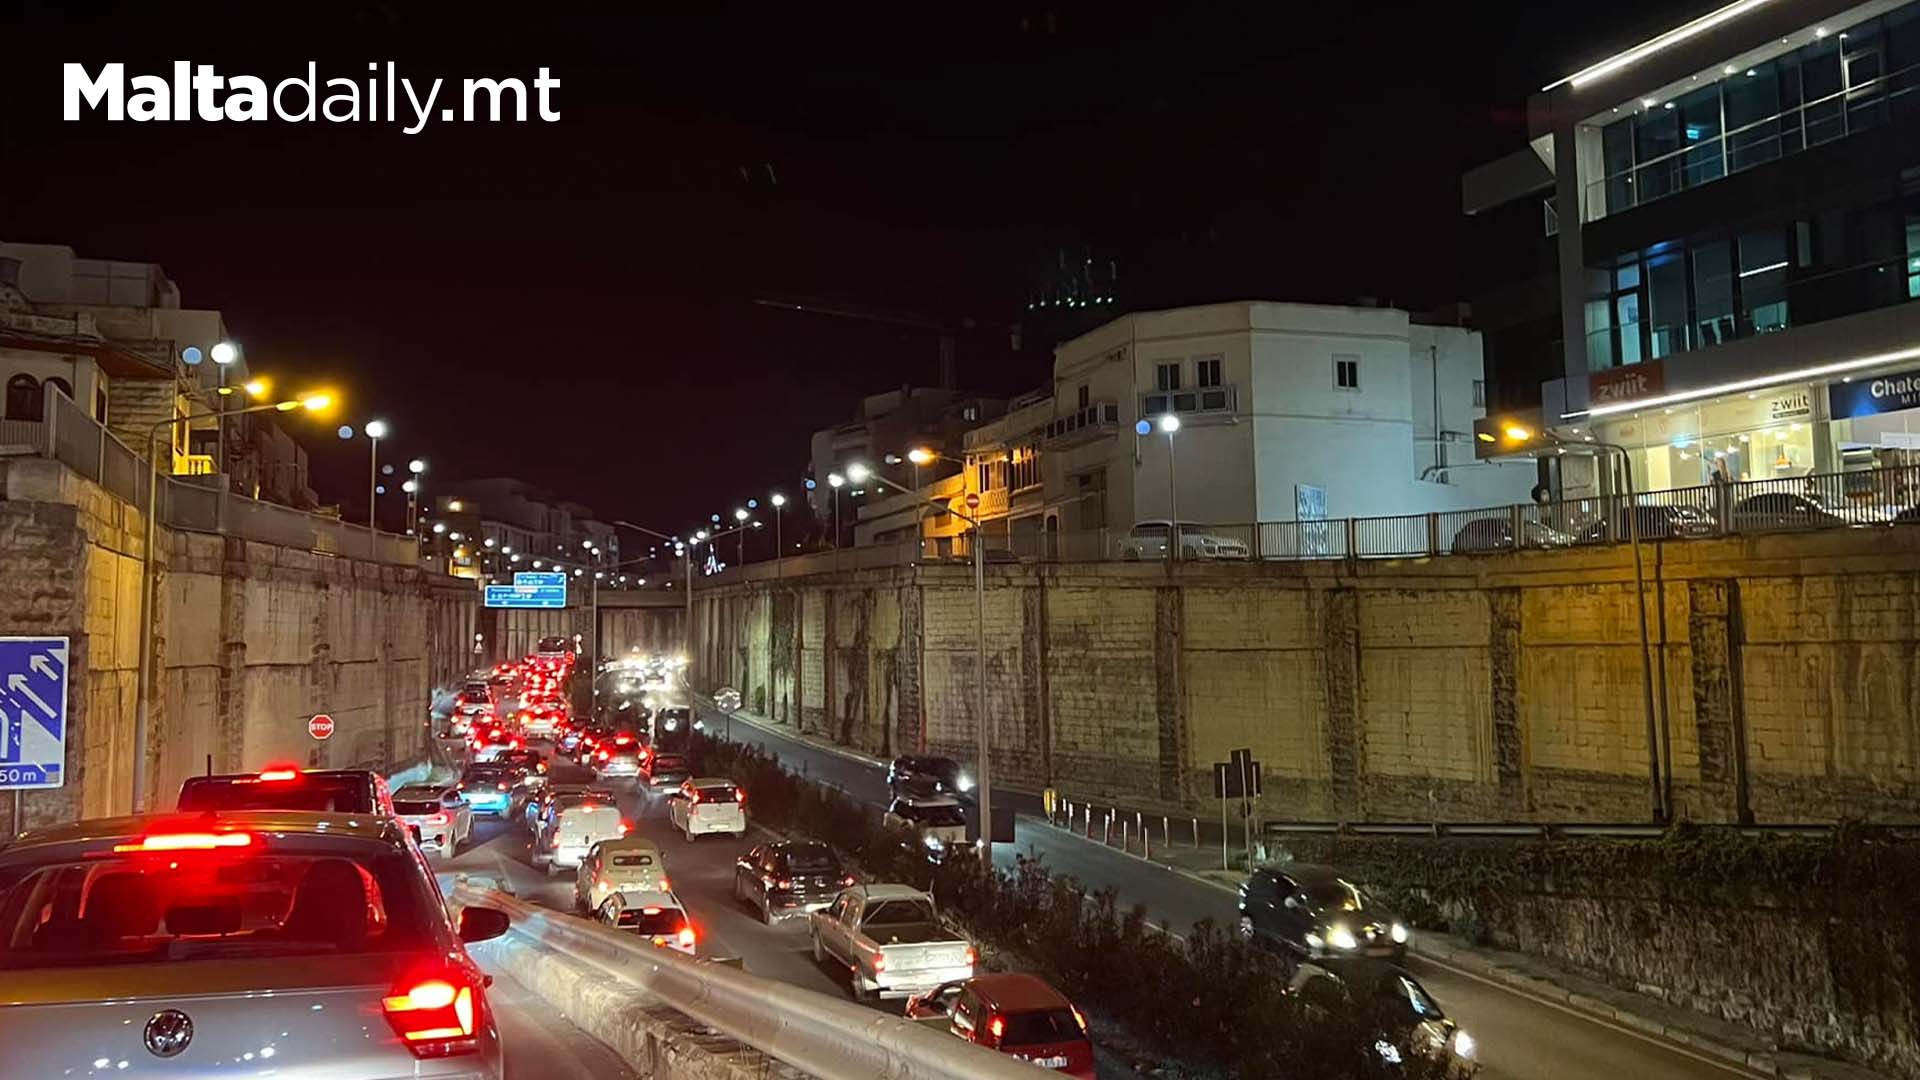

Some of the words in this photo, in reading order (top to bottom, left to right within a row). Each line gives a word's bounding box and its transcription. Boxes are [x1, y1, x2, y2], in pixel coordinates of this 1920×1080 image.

[1598, 372, 1648, 401] zwiit
[1771, 391, 1809, 412] zwiit
[311, 723, 333, 732] STOP
[22, 771, 37, 782] m
